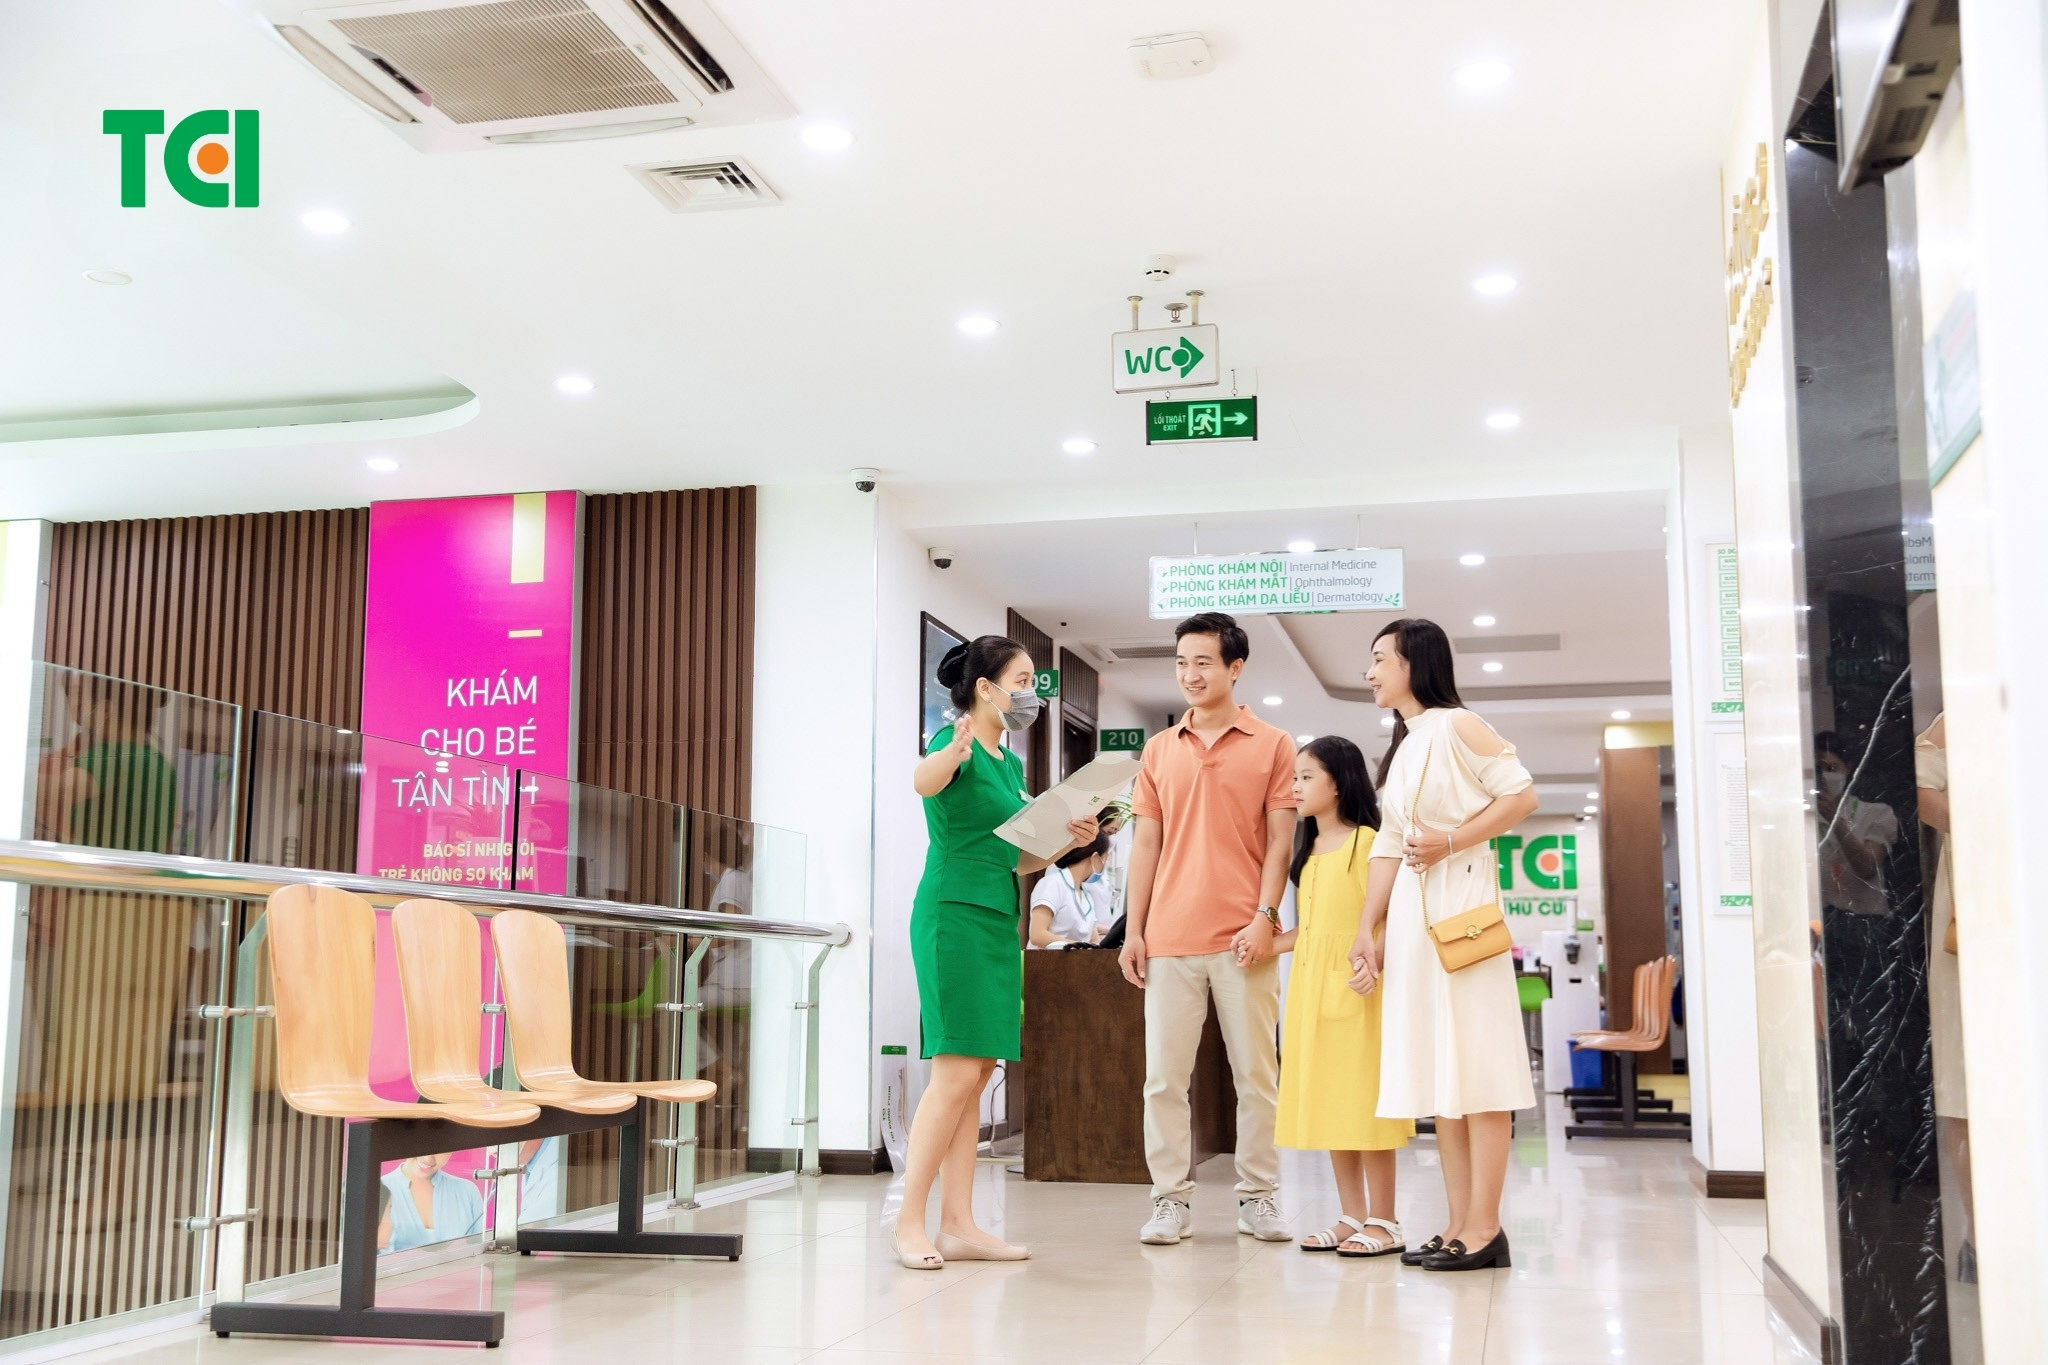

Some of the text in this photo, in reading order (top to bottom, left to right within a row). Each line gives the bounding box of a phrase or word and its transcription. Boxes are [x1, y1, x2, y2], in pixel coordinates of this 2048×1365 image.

[1125, 346, 1171, 374] WC
[1154, 412, 1186, 424] LỐI THOÁT
[1170, 563, 1214, 576] PHÒNG
[1219, 560, 1256, 574] KHÁM
[1290, 561, 1328, 572] Internal
[1332, 560, 1377, 570] Medicine
[1170, 578, 1214, 592] PHÒNG
[1219, 576, 1256, 589] KHÁM
[1295, 577, 1372, 589] Ophthalmology
[1170, 587, 1383, 608] PHÒNG KHÁM DA LIỄU Dermatology
[447, 669, 537, 707] KHÁM
[421, 718, 536, 756] CHO BÉ
[1108, 731, 1138, 746] 210
[392, 771, 453, 813] TẬN
[423, 841, 453, 858] BÁC
[457, 841, 472, 857] SĨ
[503, 838, 534, 857] GỎI
[1490, 835, 1577, 890] TCI
[411, 866, 462, 882] KHÔNG
[466, 867, 486, 884] SỢ
